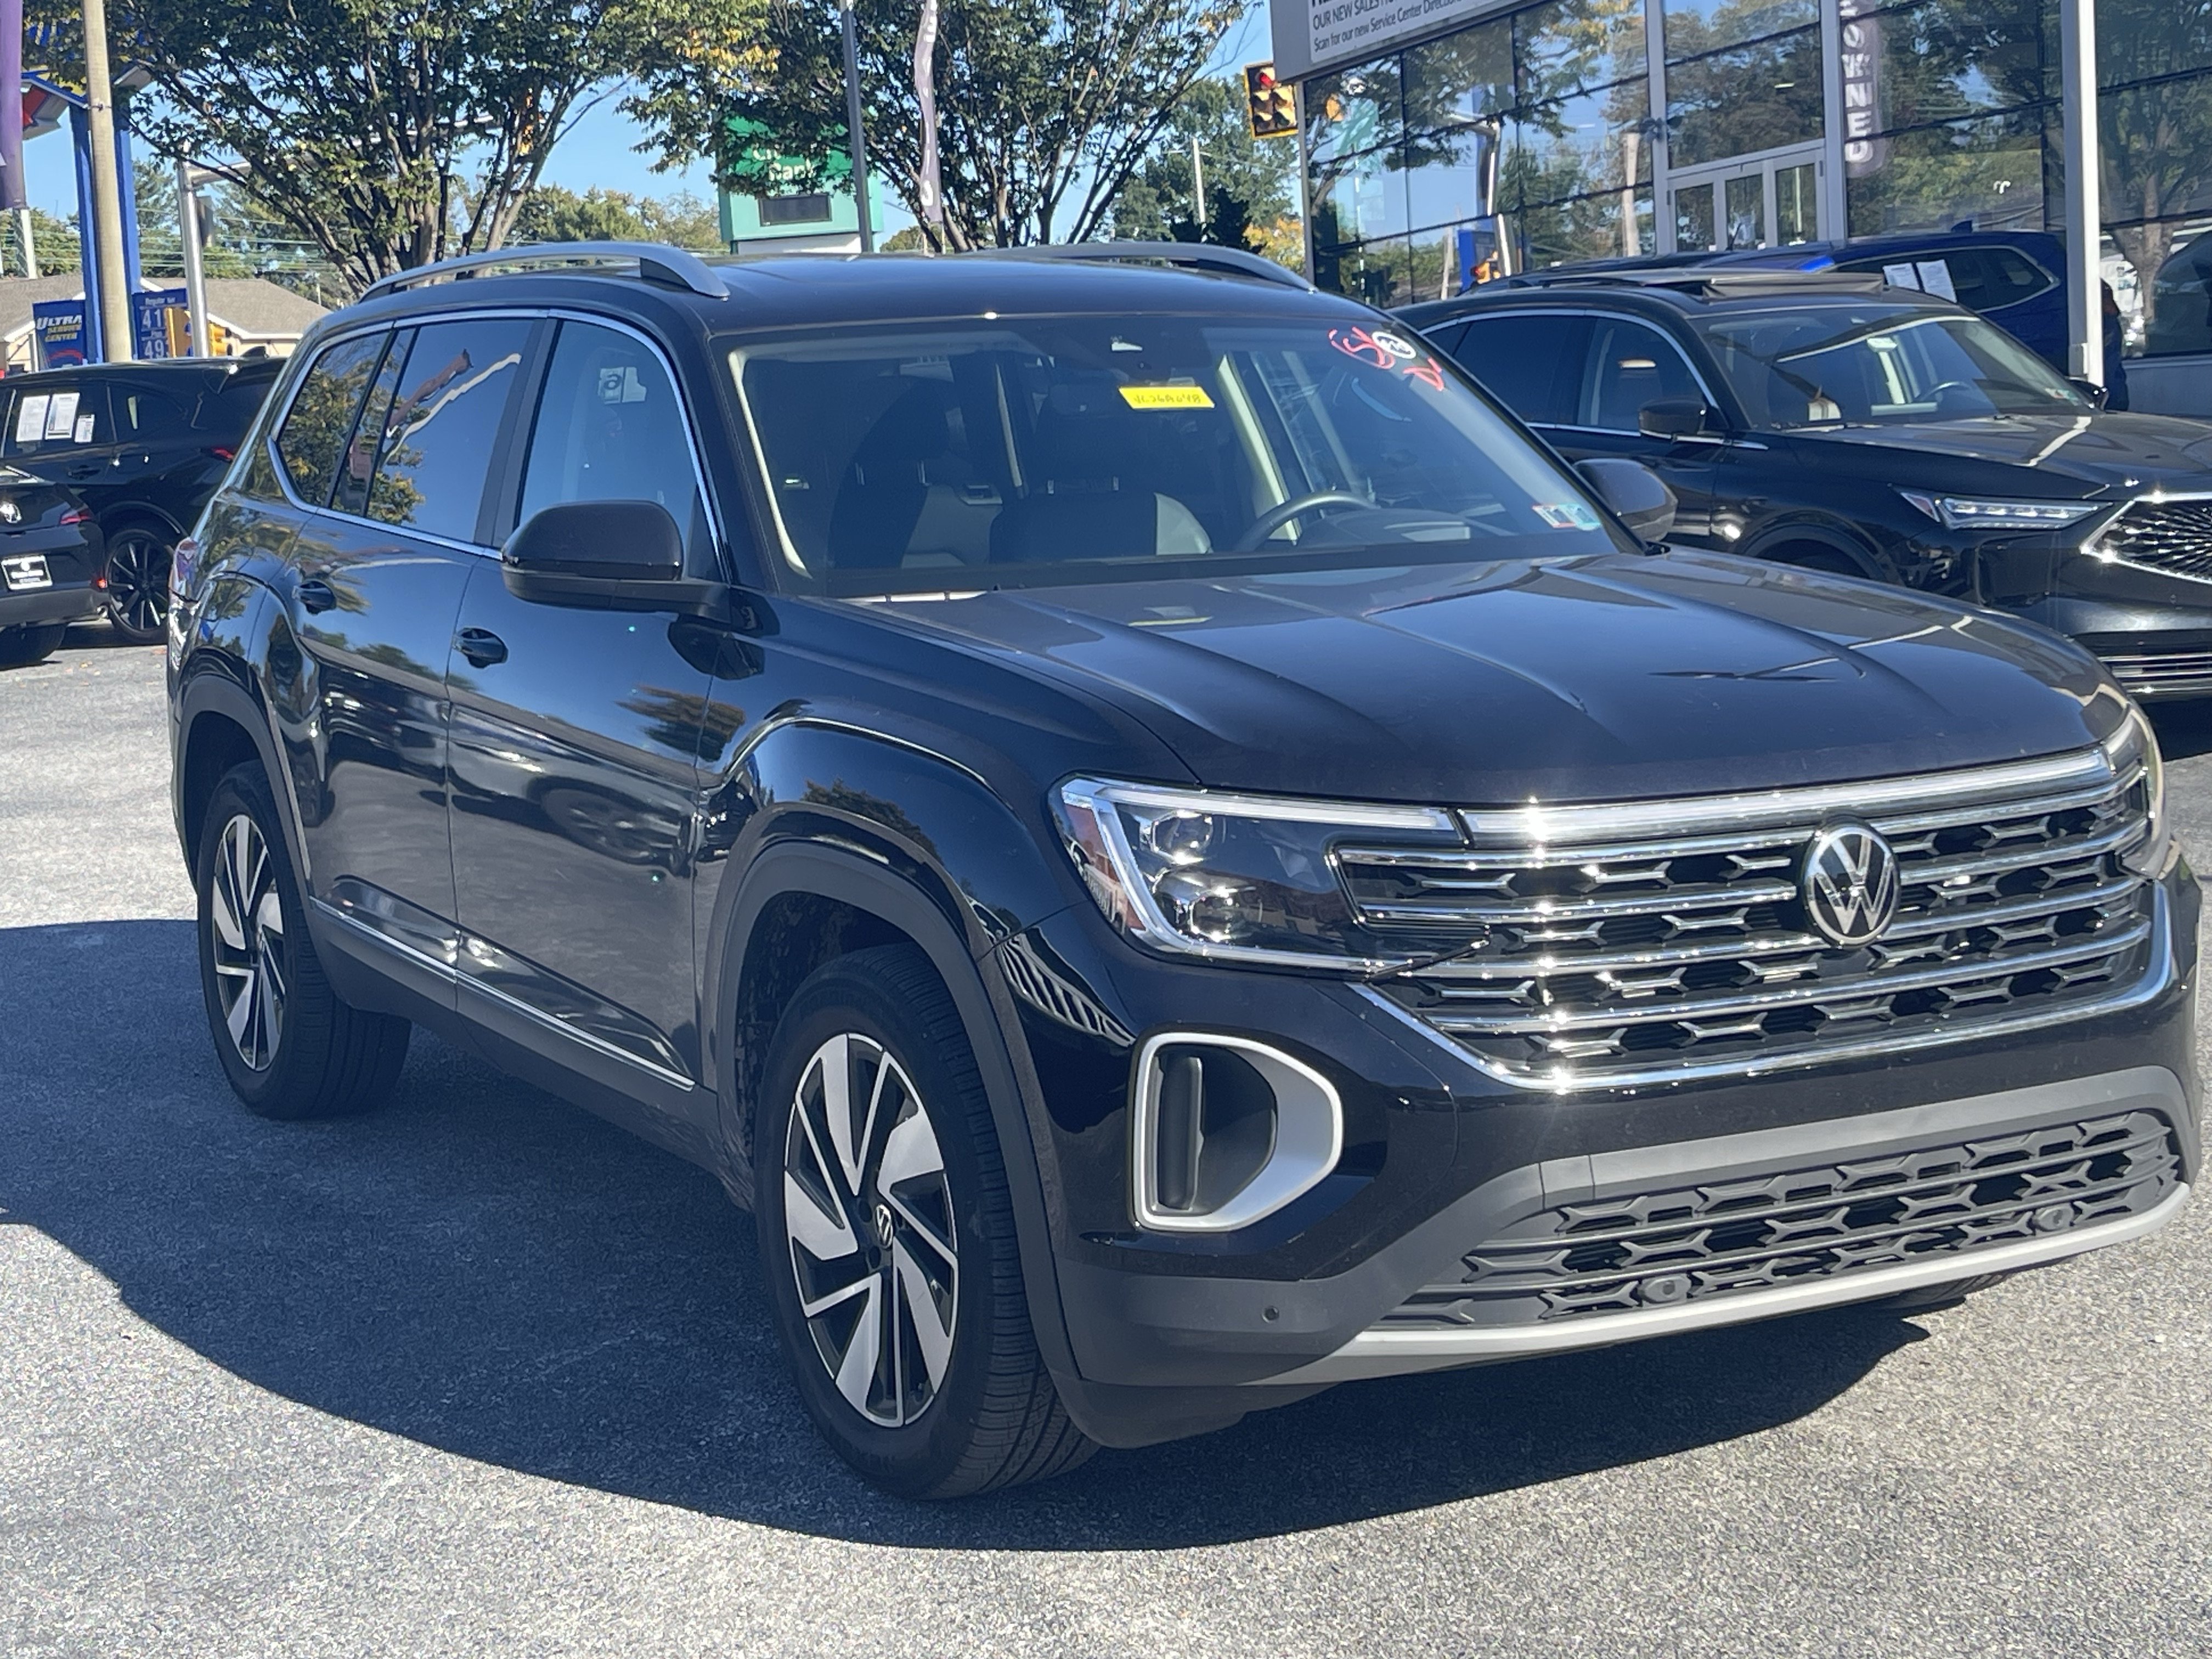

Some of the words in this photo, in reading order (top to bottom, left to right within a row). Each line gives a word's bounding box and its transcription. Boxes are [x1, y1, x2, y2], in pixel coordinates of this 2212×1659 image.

[1312, 10, 1331, 30] OUR
[1333, 1, 1353, 24] NEW
[1313, 36, 1330, 53] Scan
[1330, 32, 1341, 46] for
[1341, 29, 1353, 42] our
[1354, 24, 1369, 38] new
[1370, 12, 1396, 32] Service
[1397, 4, 1421, 22] Center
[36, 314, 82, 330] ULTRA
